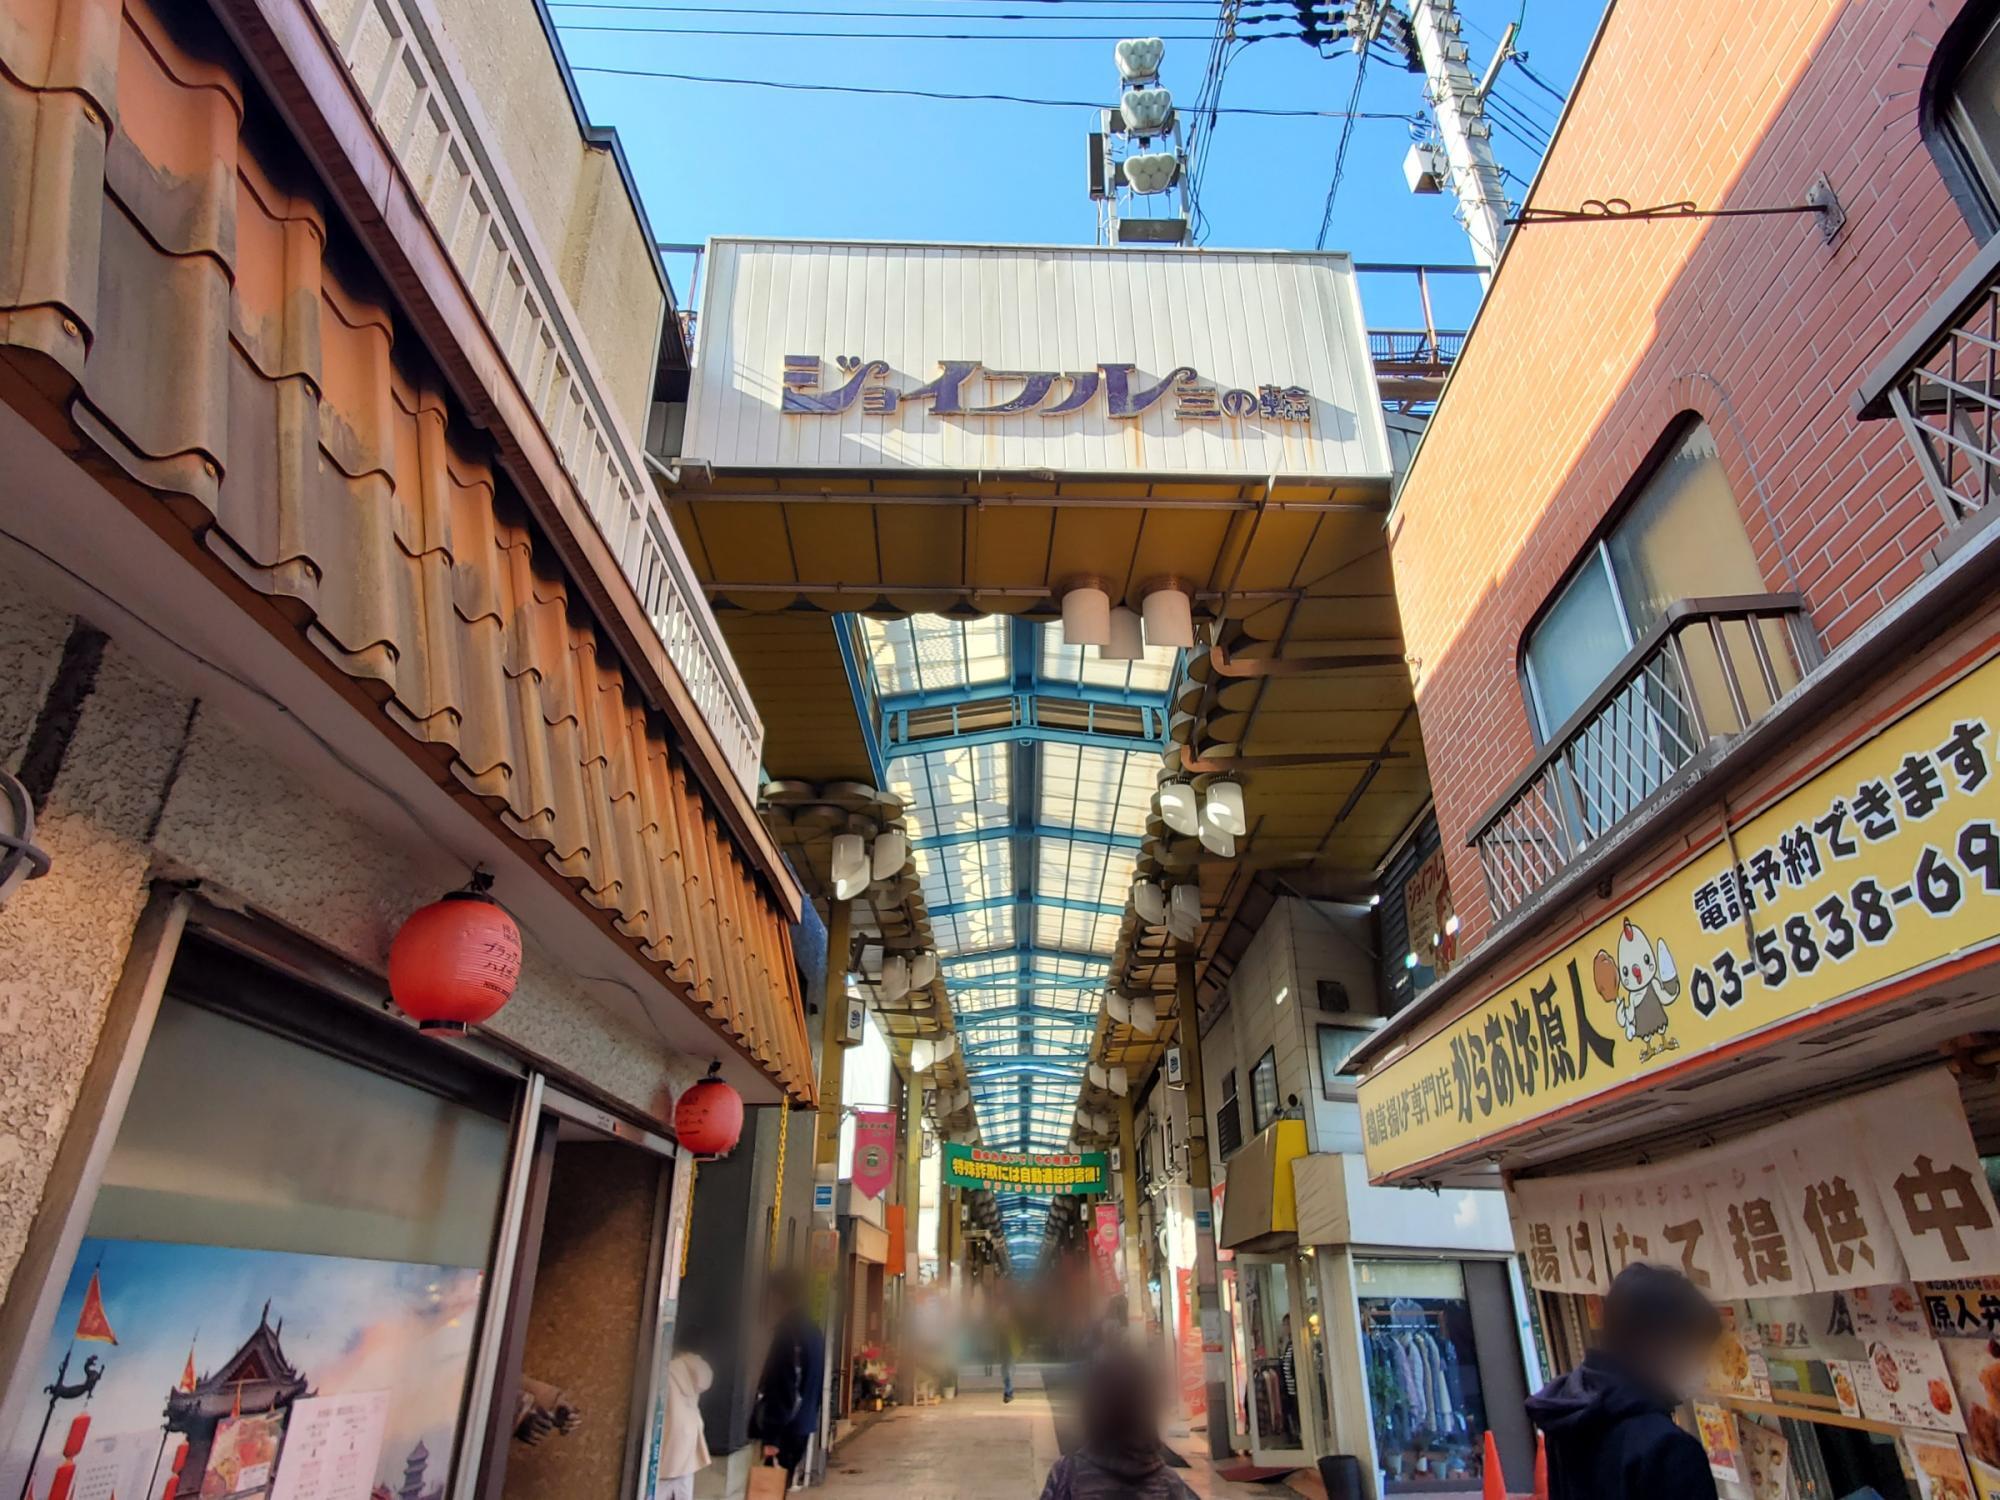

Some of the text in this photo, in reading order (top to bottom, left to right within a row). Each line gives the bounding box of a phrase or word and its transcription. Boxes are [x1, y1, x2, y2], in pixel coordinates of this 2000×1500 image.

[1694, 722, 1989, 930] 電話予約できます
[1365, 1066, 1454, 1147] 鶏唐揚げ専門店
[1449, 957, 1616, 1124] からあげ原人
